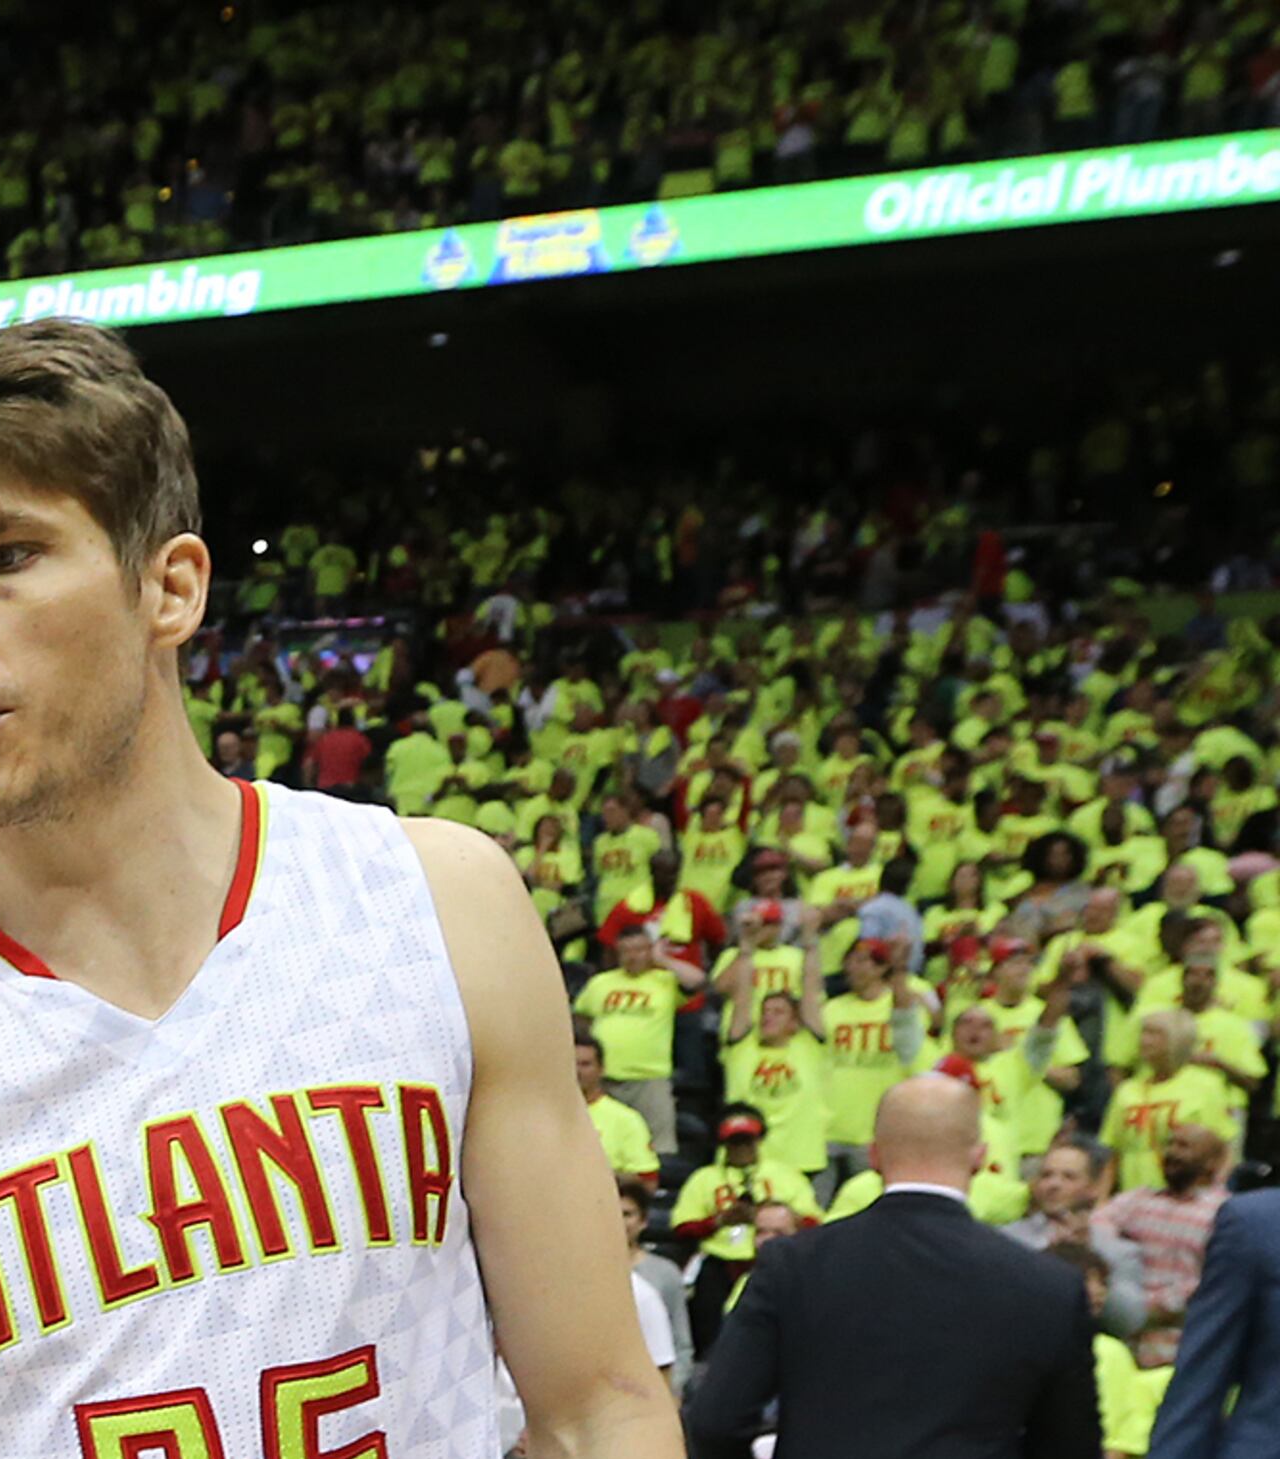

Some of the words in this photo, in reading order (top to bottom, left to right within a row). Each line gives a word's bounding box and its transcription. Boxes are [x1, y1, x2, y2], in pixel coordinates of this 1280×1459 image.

[864, 163, 1068, 234] Official
[1069, 142, 1280, 212] Plumbe
[22, 266, 261, 322] Plumbing
